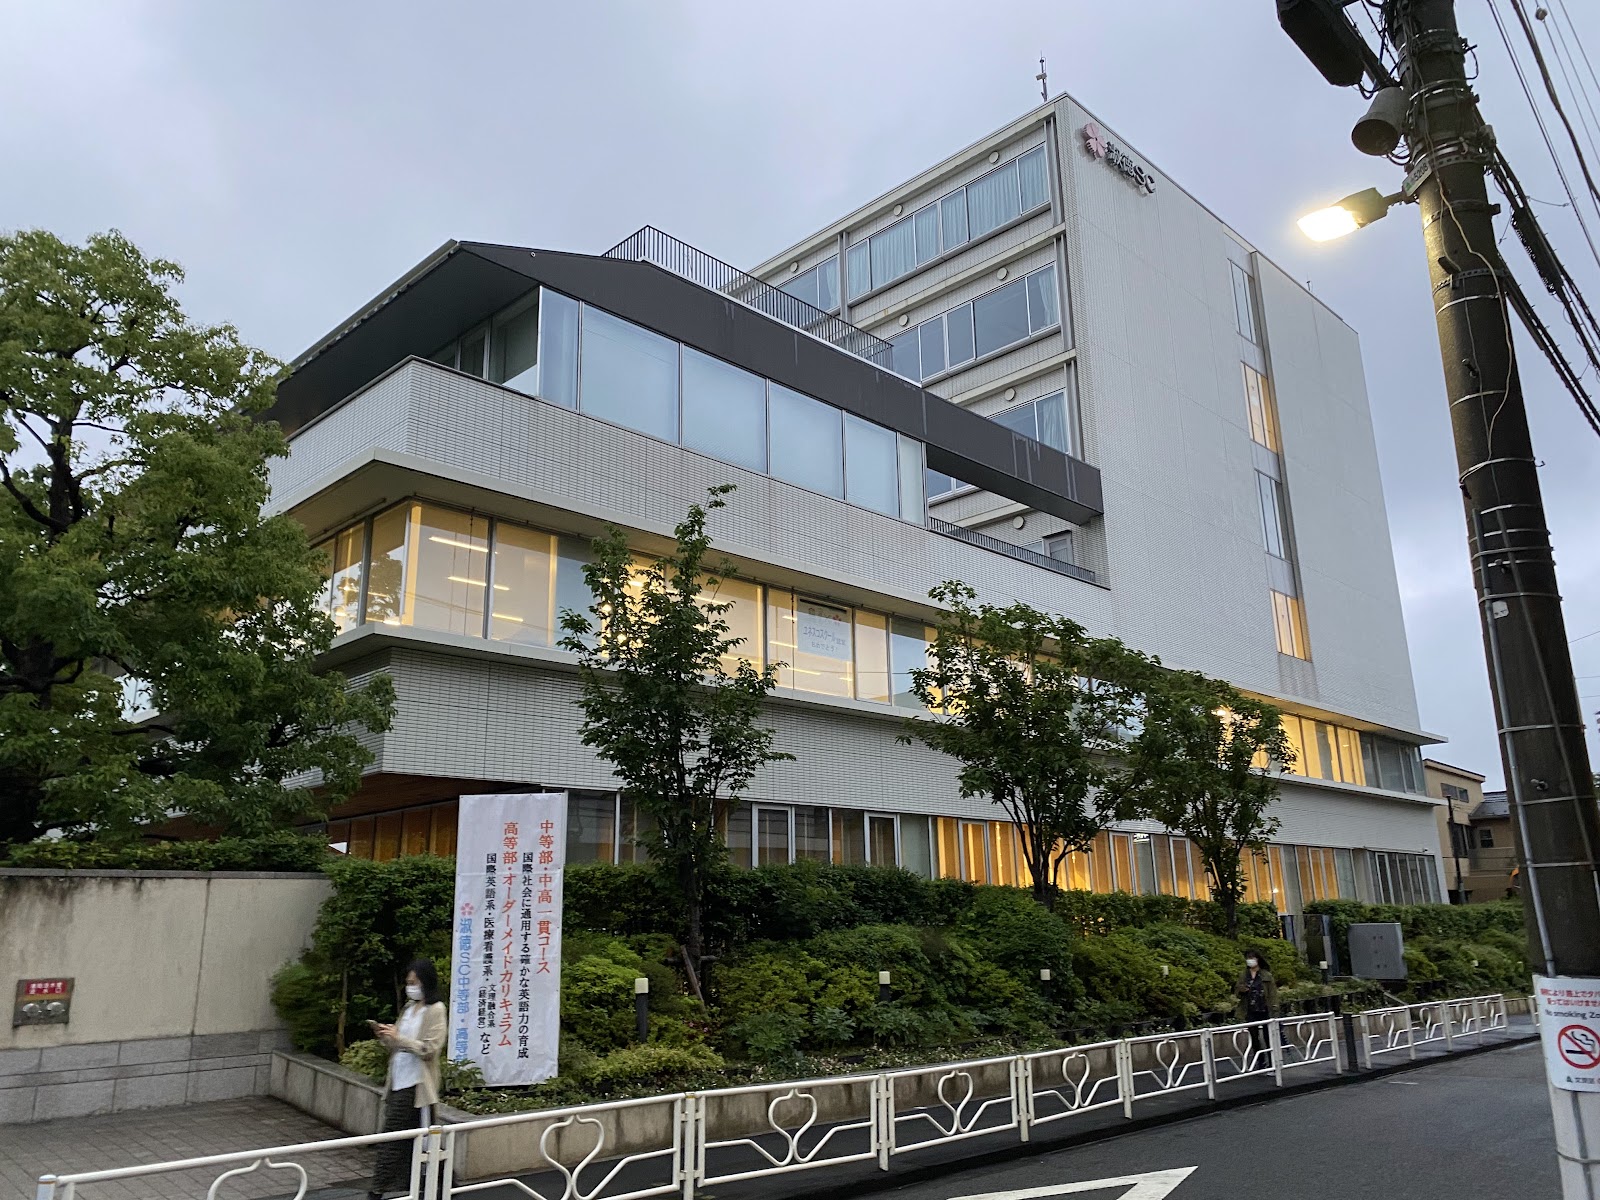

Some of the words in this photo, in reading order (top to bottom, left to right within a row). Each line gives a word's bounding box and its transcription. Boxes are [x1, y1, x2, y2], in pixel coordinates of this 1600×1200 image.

[498, 822, 518, 1046] 高等部・オーダーメイドカリキュラム
[517, 852, 533, 1059] 国際社会に通用する確かな英語力の育成
[536, 819, 554, 974] 中等部・中高一貫コース
[480, 1032, 491, 1055] など
[1553, 1011, 1587, 1020] smoking
